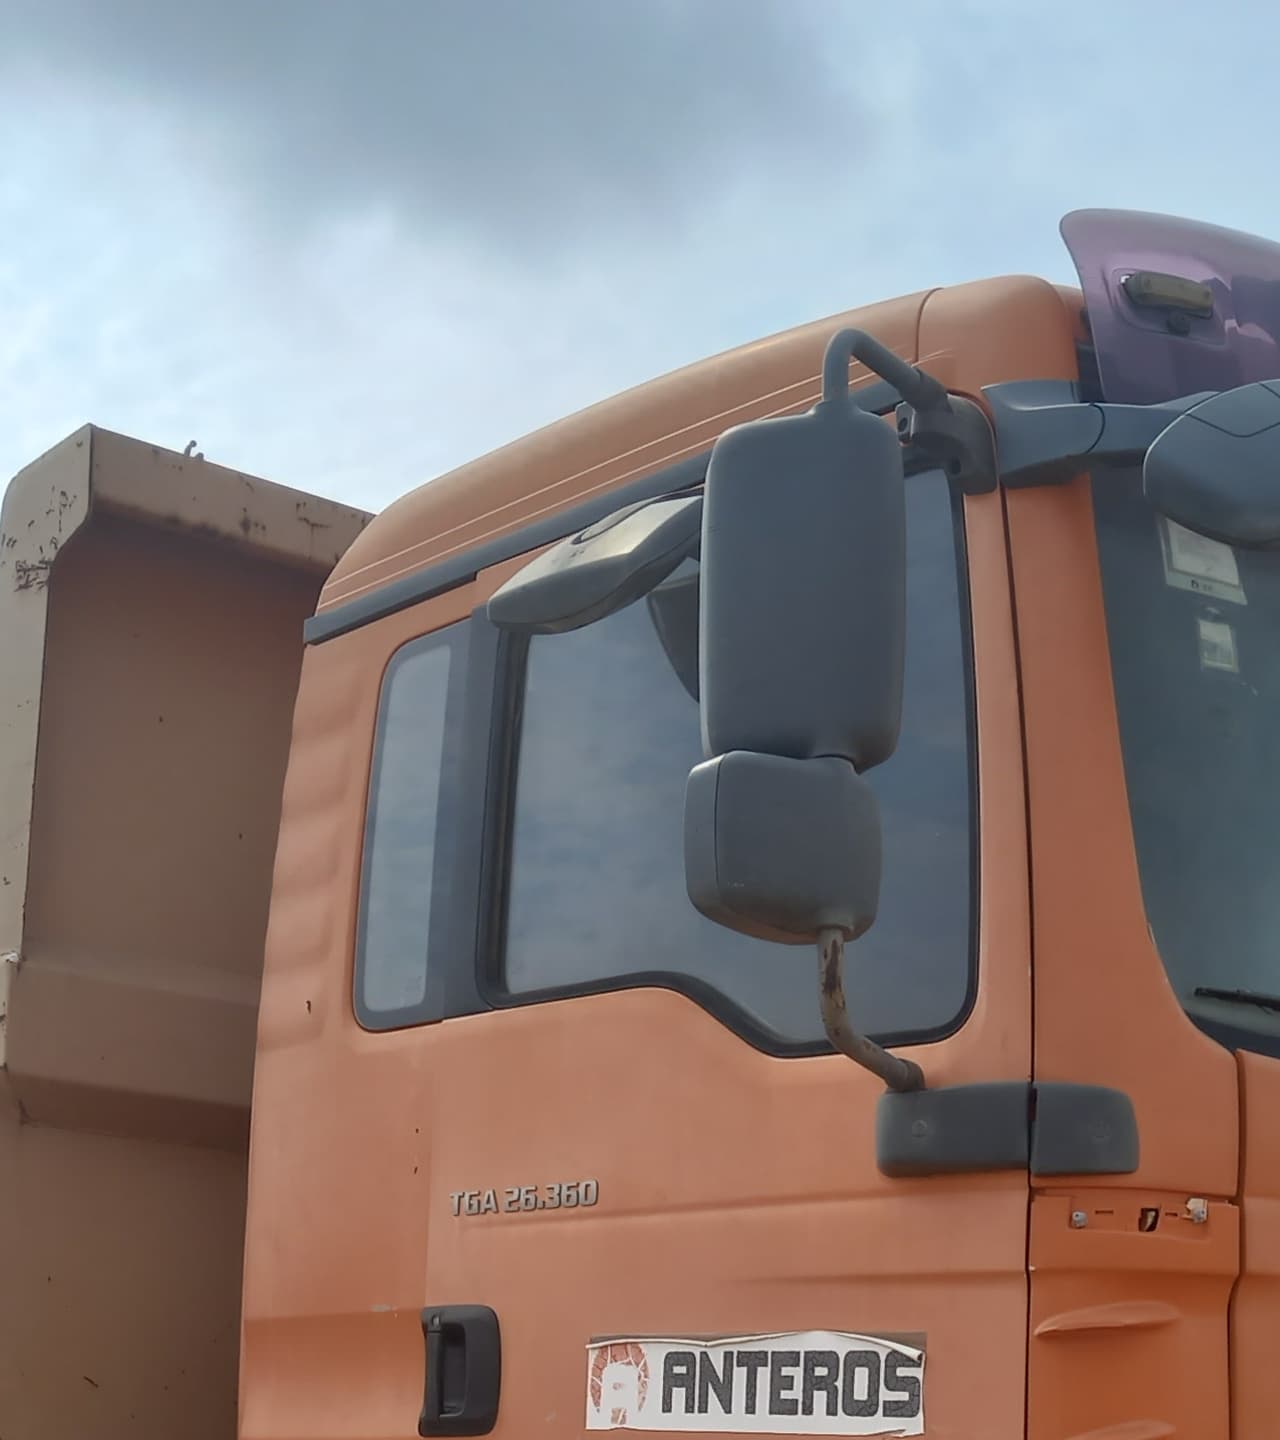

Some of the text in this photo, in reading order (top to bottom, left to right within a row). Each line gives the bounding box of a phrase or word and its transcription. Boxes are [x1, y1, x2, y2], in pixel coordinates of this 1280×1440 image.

[449, 1179, 600, 1217] TGA 26.360
[661, 1349, 920, 1418] ANTEROS
